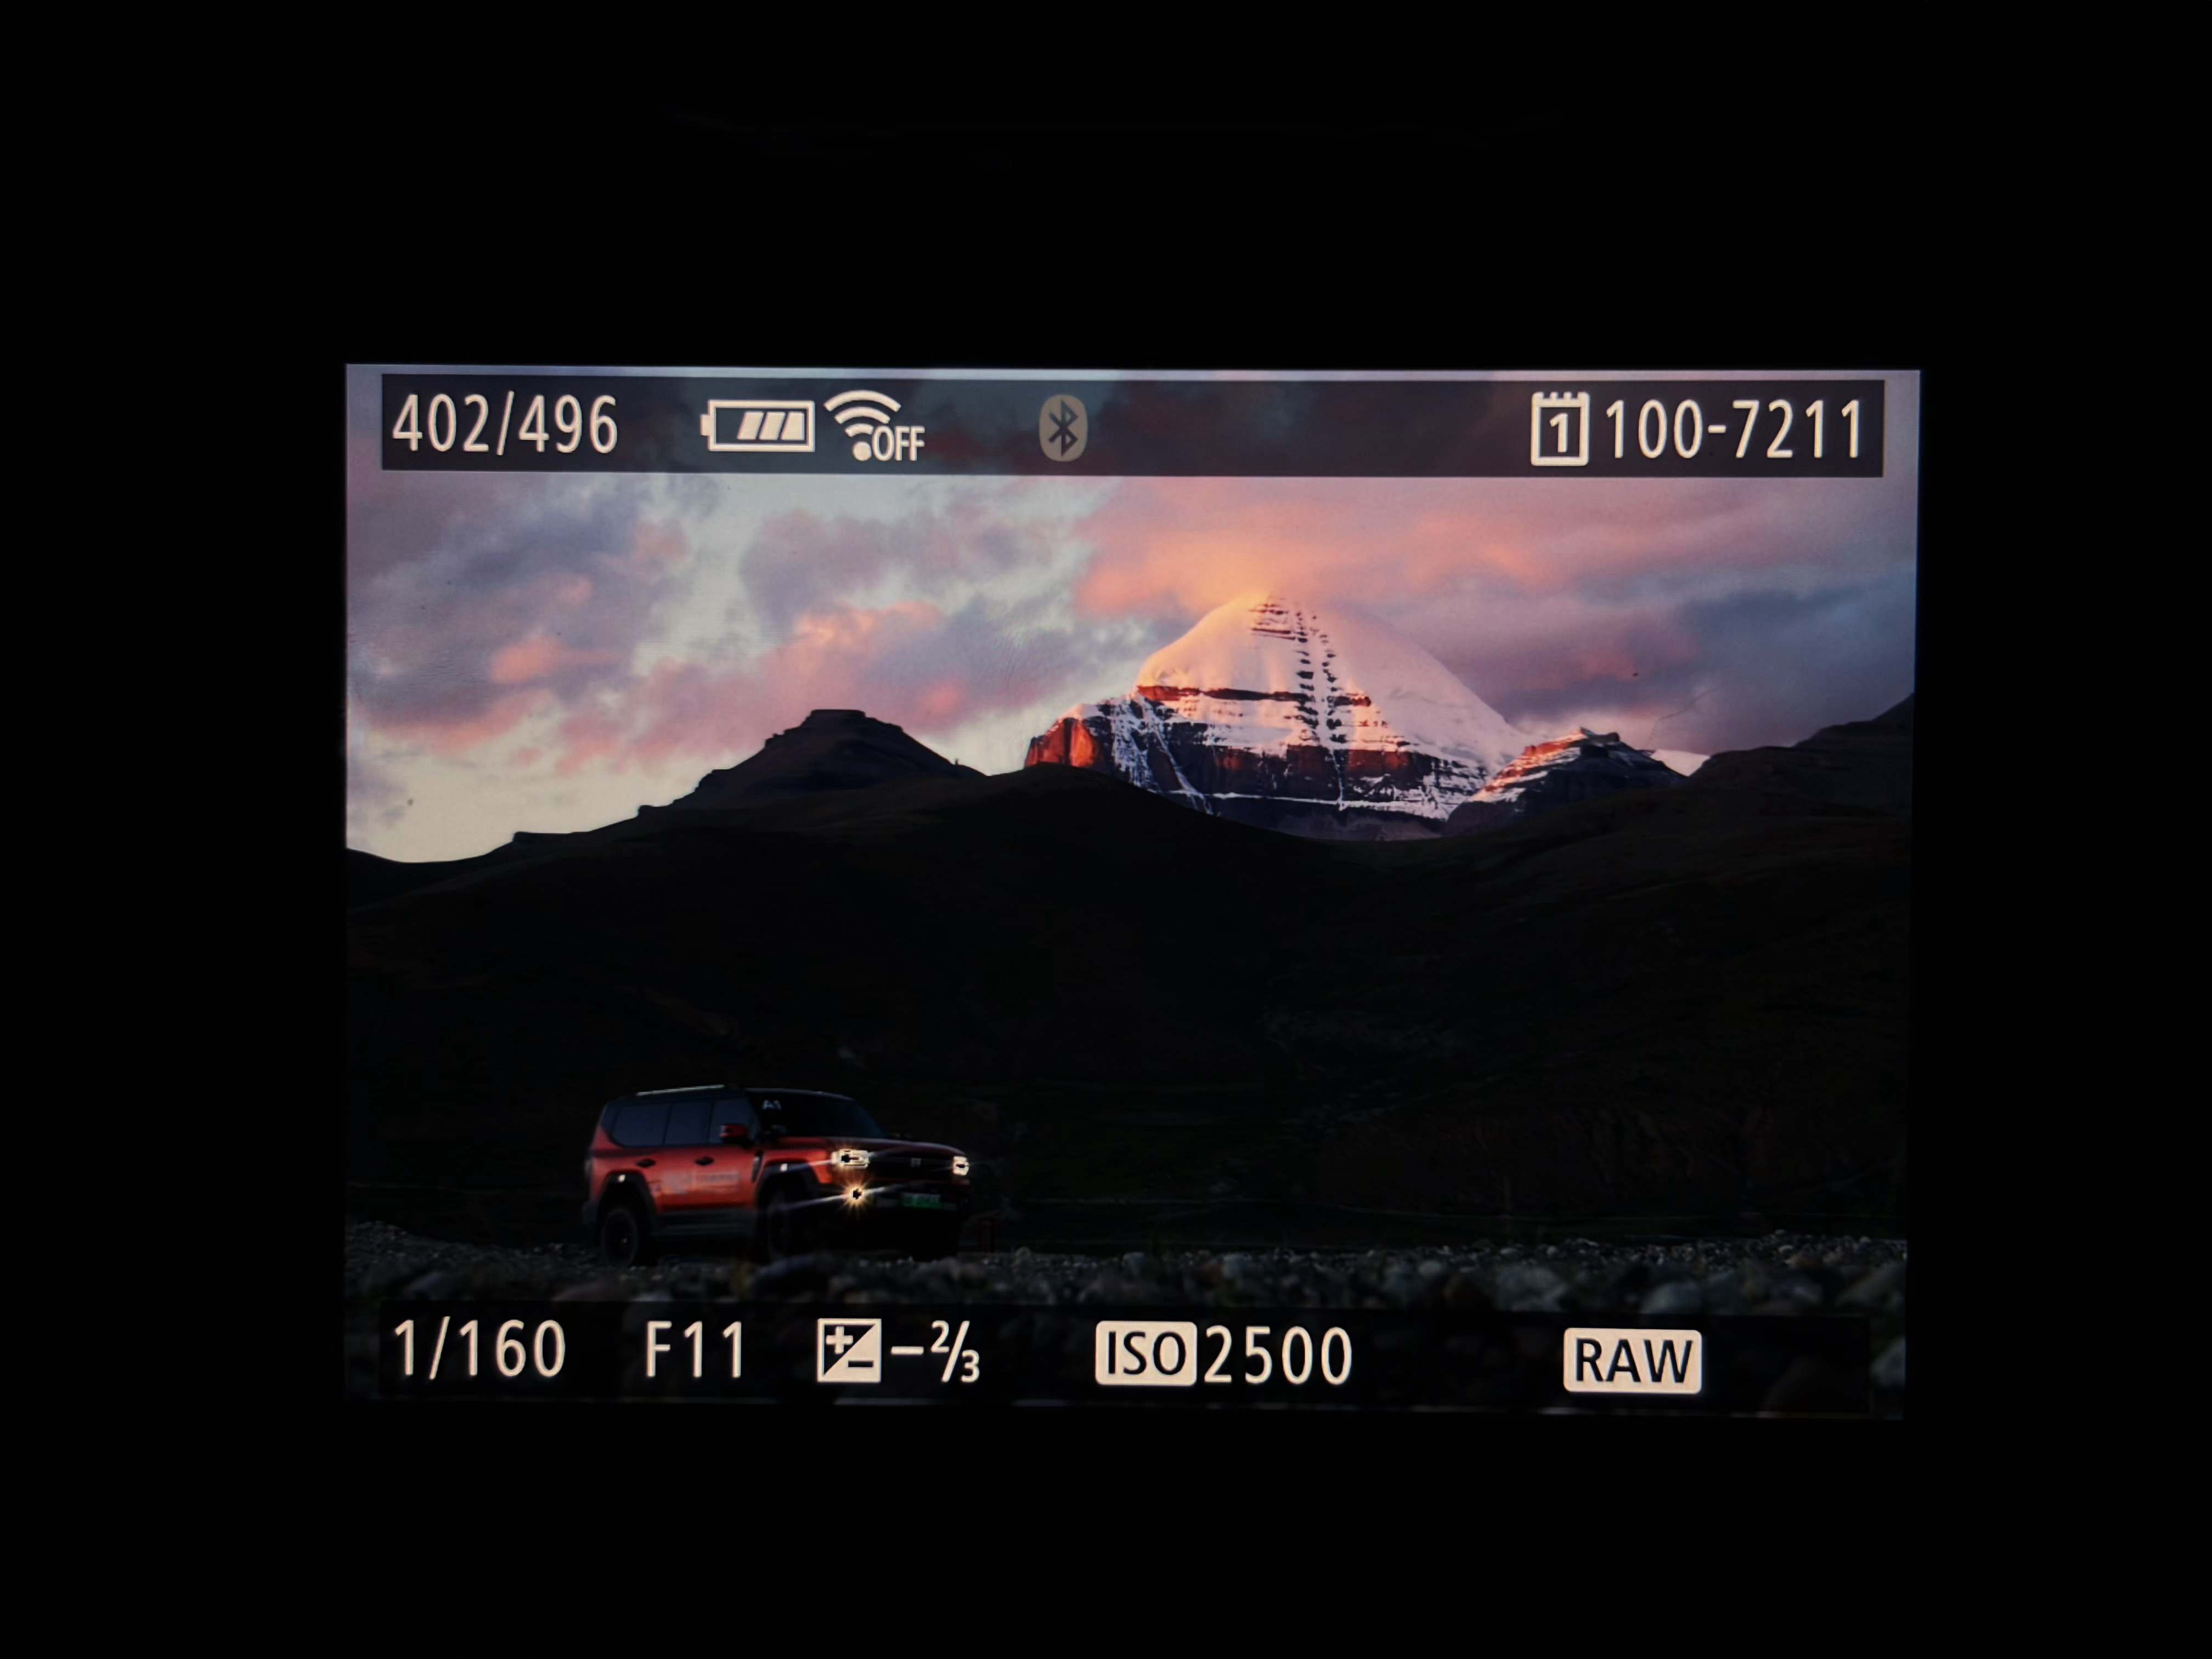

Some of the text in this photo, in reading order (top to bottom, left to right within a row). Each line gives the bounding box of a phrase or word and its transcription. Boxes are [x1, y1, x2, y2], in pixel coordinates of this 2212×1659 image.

[392, 391, 618, 455] 402/496
[872, 426, 926, 461] OFF
[1549, 399, 1860, 459] 1 100-7211
[394, 1316, 566, 1380] 1/160
[646, 1321, 742, 1378] F11
[1108, 1324, 1352, 1385] ISO 2500
[1576, 1338, 1693, 1384] RAW
